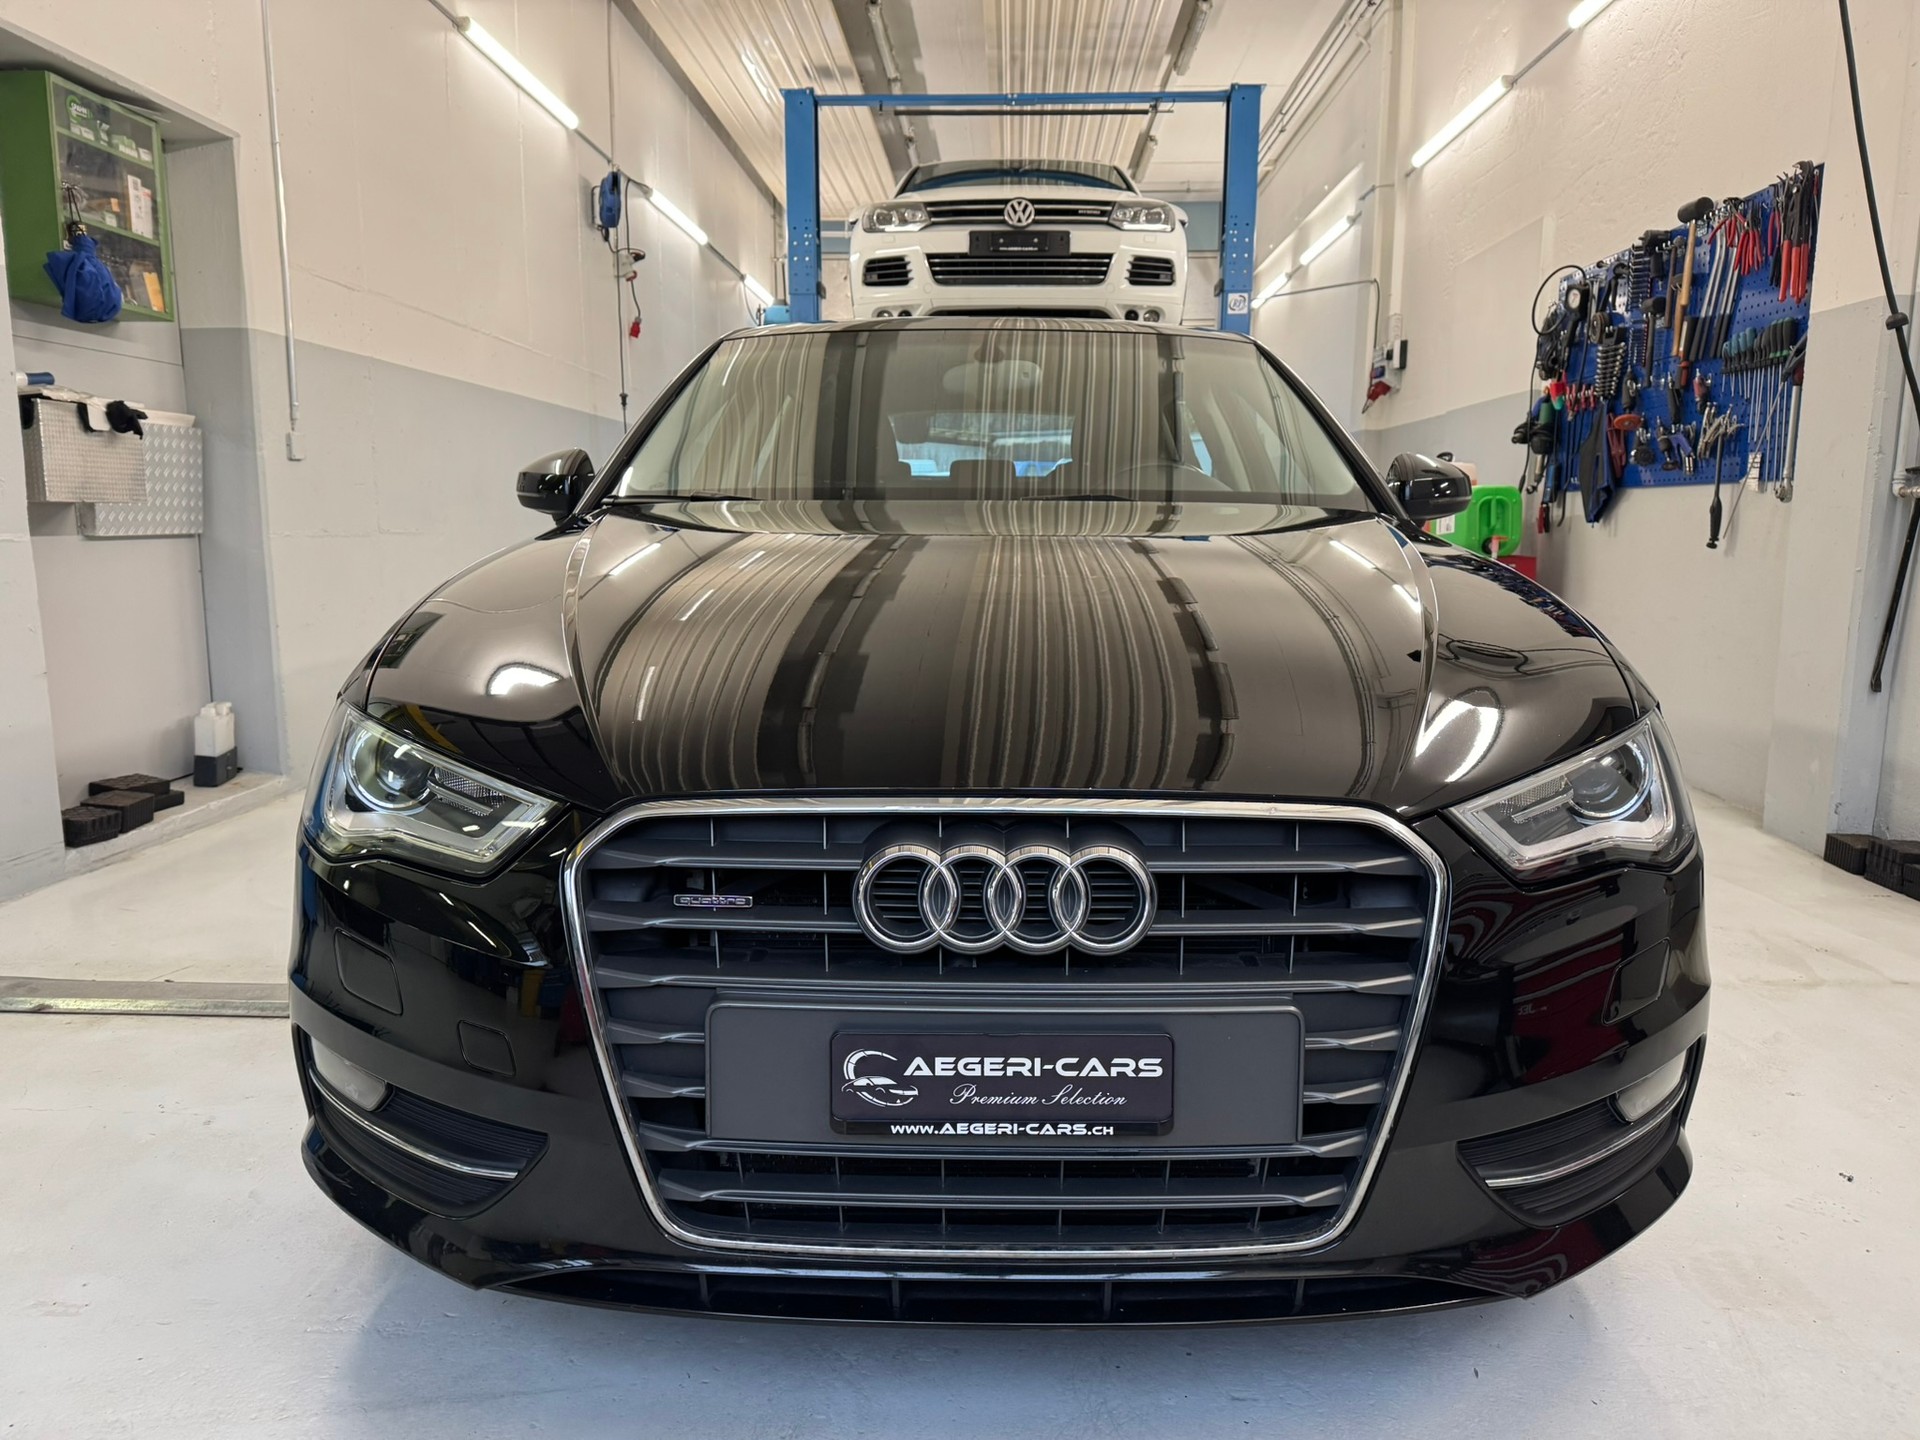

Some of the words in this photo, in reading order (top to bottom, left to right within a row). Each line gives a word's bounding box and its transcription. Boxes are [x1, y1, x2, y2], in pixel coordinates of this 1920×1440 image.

[679, 896, 746, 905] quattro
[903, 1057, 1163, 1078] AEGERI-CARS
[949, 1083, 1039, 1106] Premium
[1042, 1084, 1127, 1106] Selection
